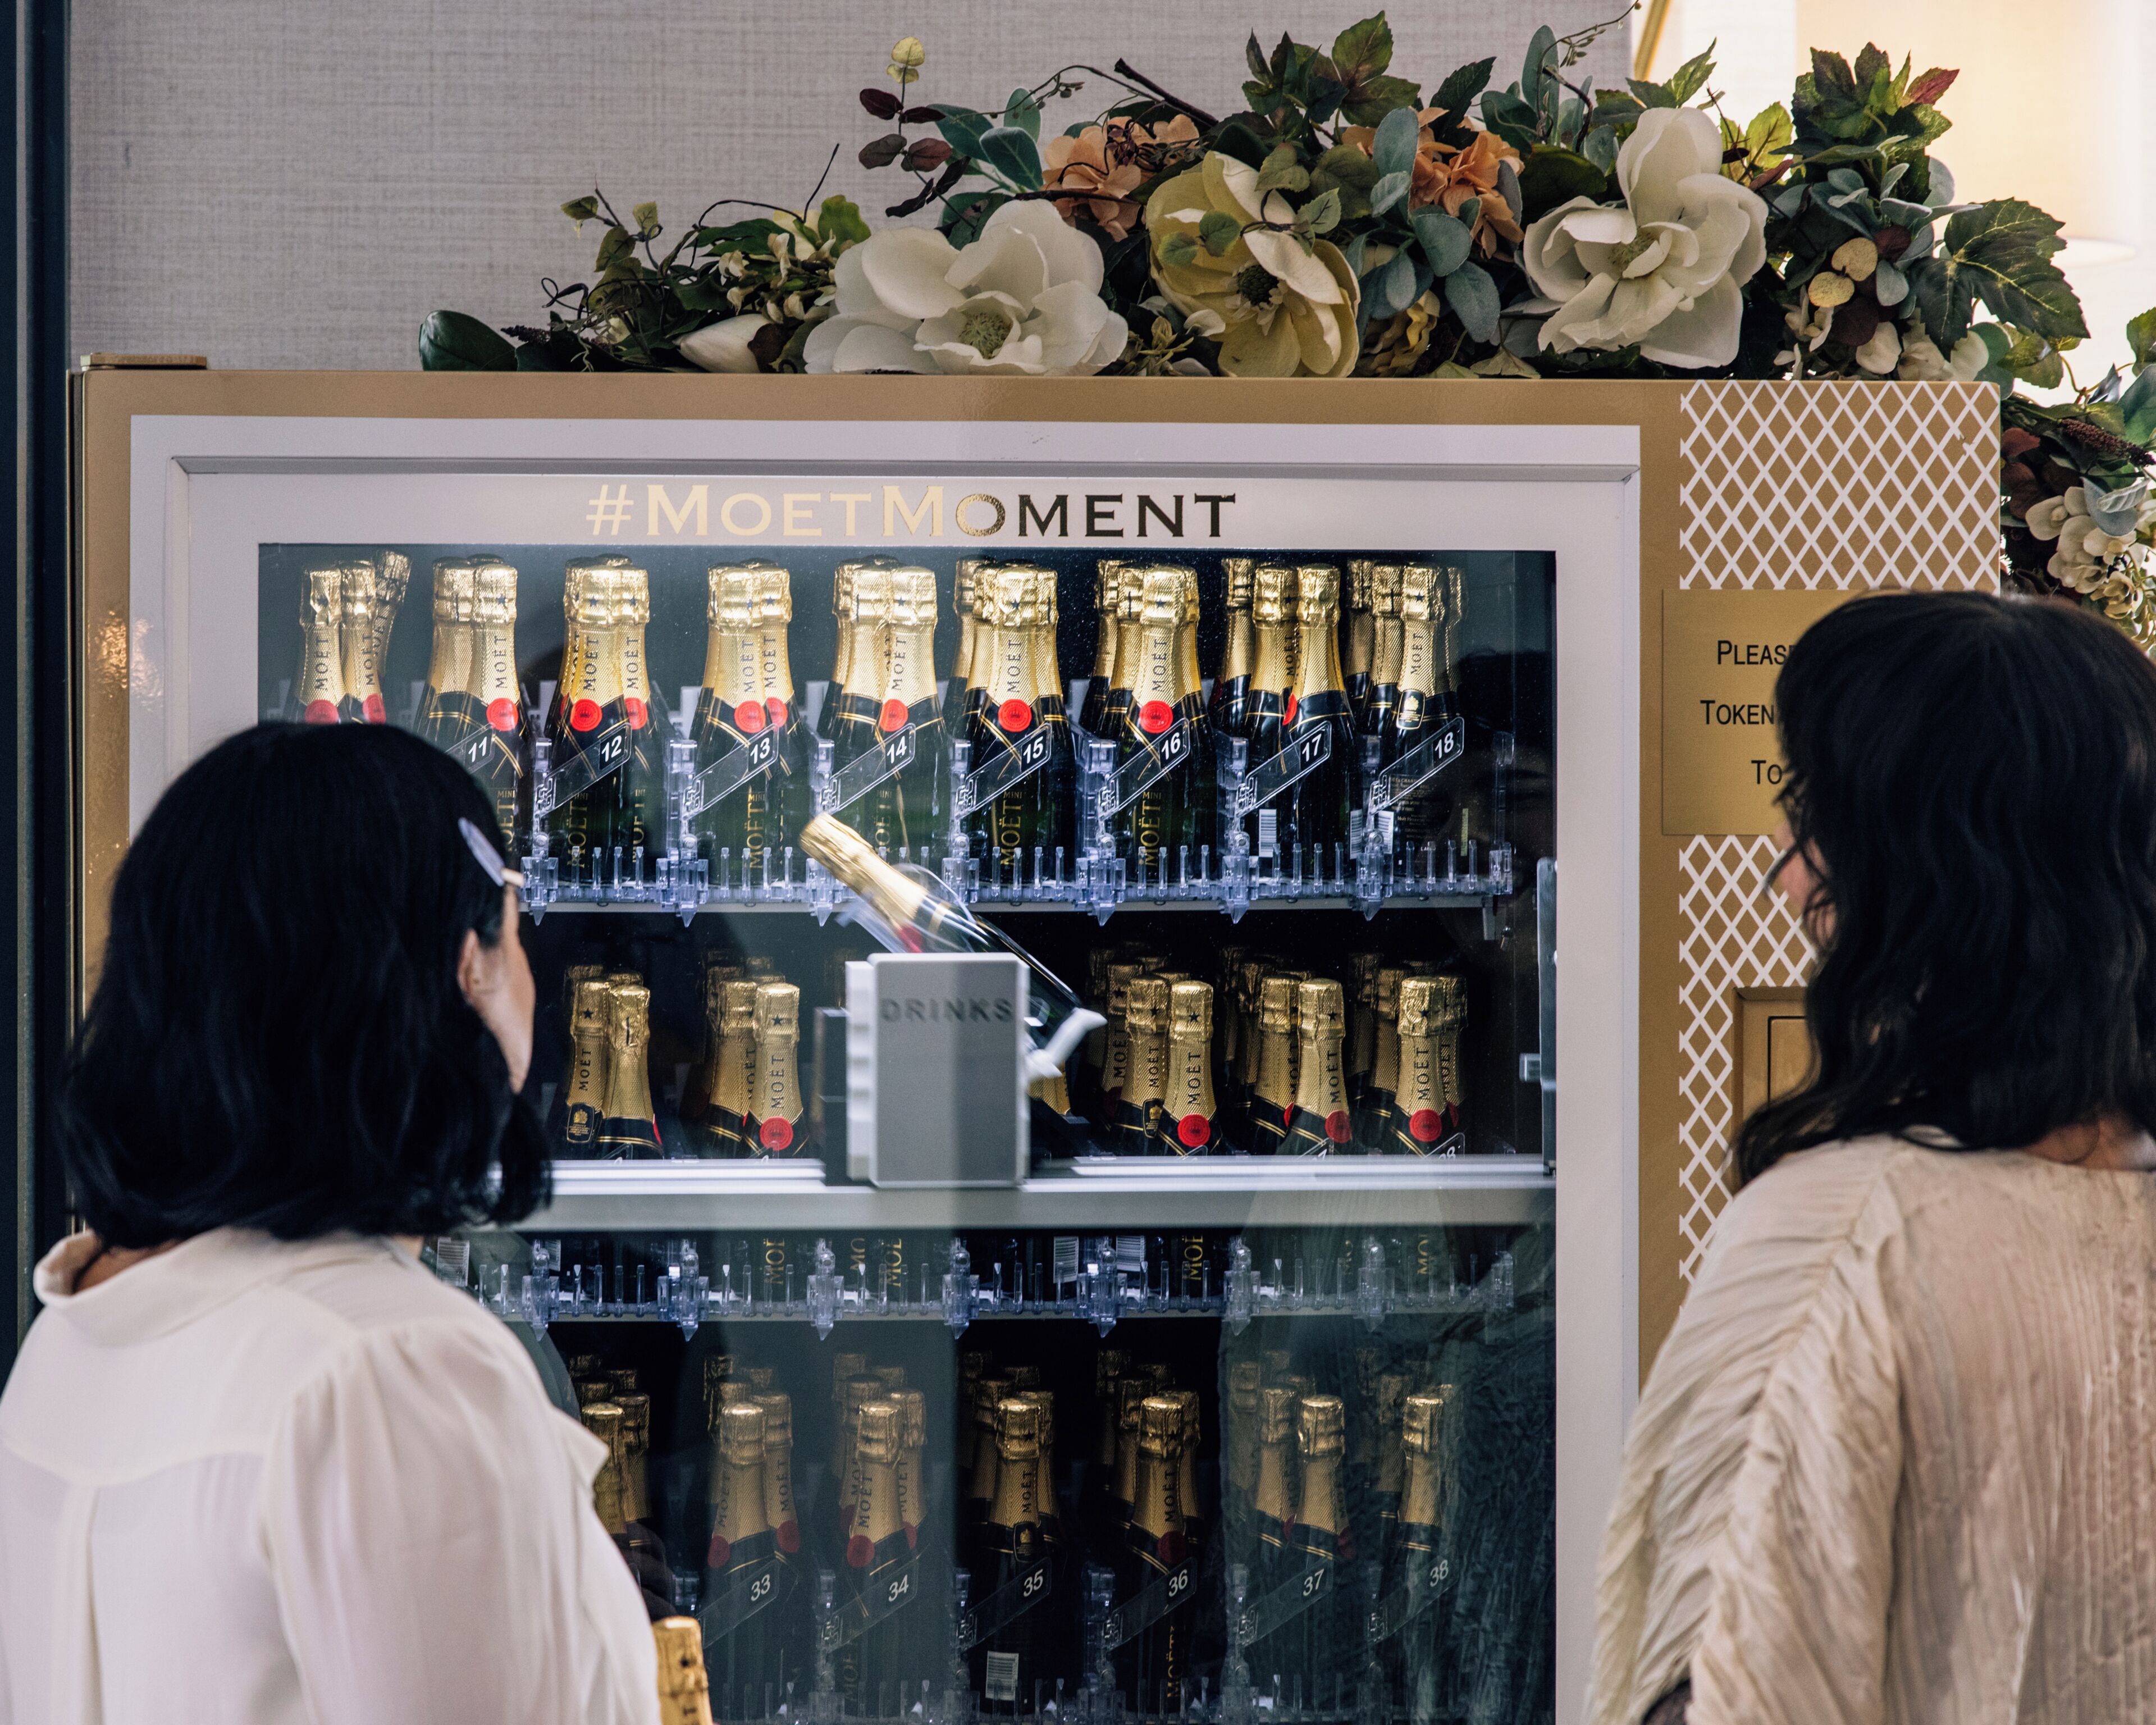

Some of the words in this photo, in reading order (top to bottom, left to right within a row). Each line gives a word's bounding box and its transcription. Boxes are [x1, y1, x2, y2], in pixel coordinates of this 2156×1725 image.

[468, 736, 488, 763] 11
[601, 735, 623, 763] 12
[750, 737, 771, 764] 13
[887, 734, 907, 763] 14
[1022, 736, 1044, 764] 15
[1161, 731, 1181, 760] 16
[1301, 733, 1322, 763] 17
[1434, 731, 1455, 759] 18
[1751, 760, 1783, 785] TO
[999, 800, 1022, 865] MOËT
[1138, 800, 1161, 868] MOËT
[880, 998, 1012, 1023] DRINKS
[751, 1573, 771, 1602] 33
[1023, 1568, 1044, 1598] 35
[1168, 1568, 1189, 1598] 36
[1302, 1568, 1325, 1597] 37
[1429, 1559, 1449, 1587] 38
[888, 1574, 909, 1603] 34
